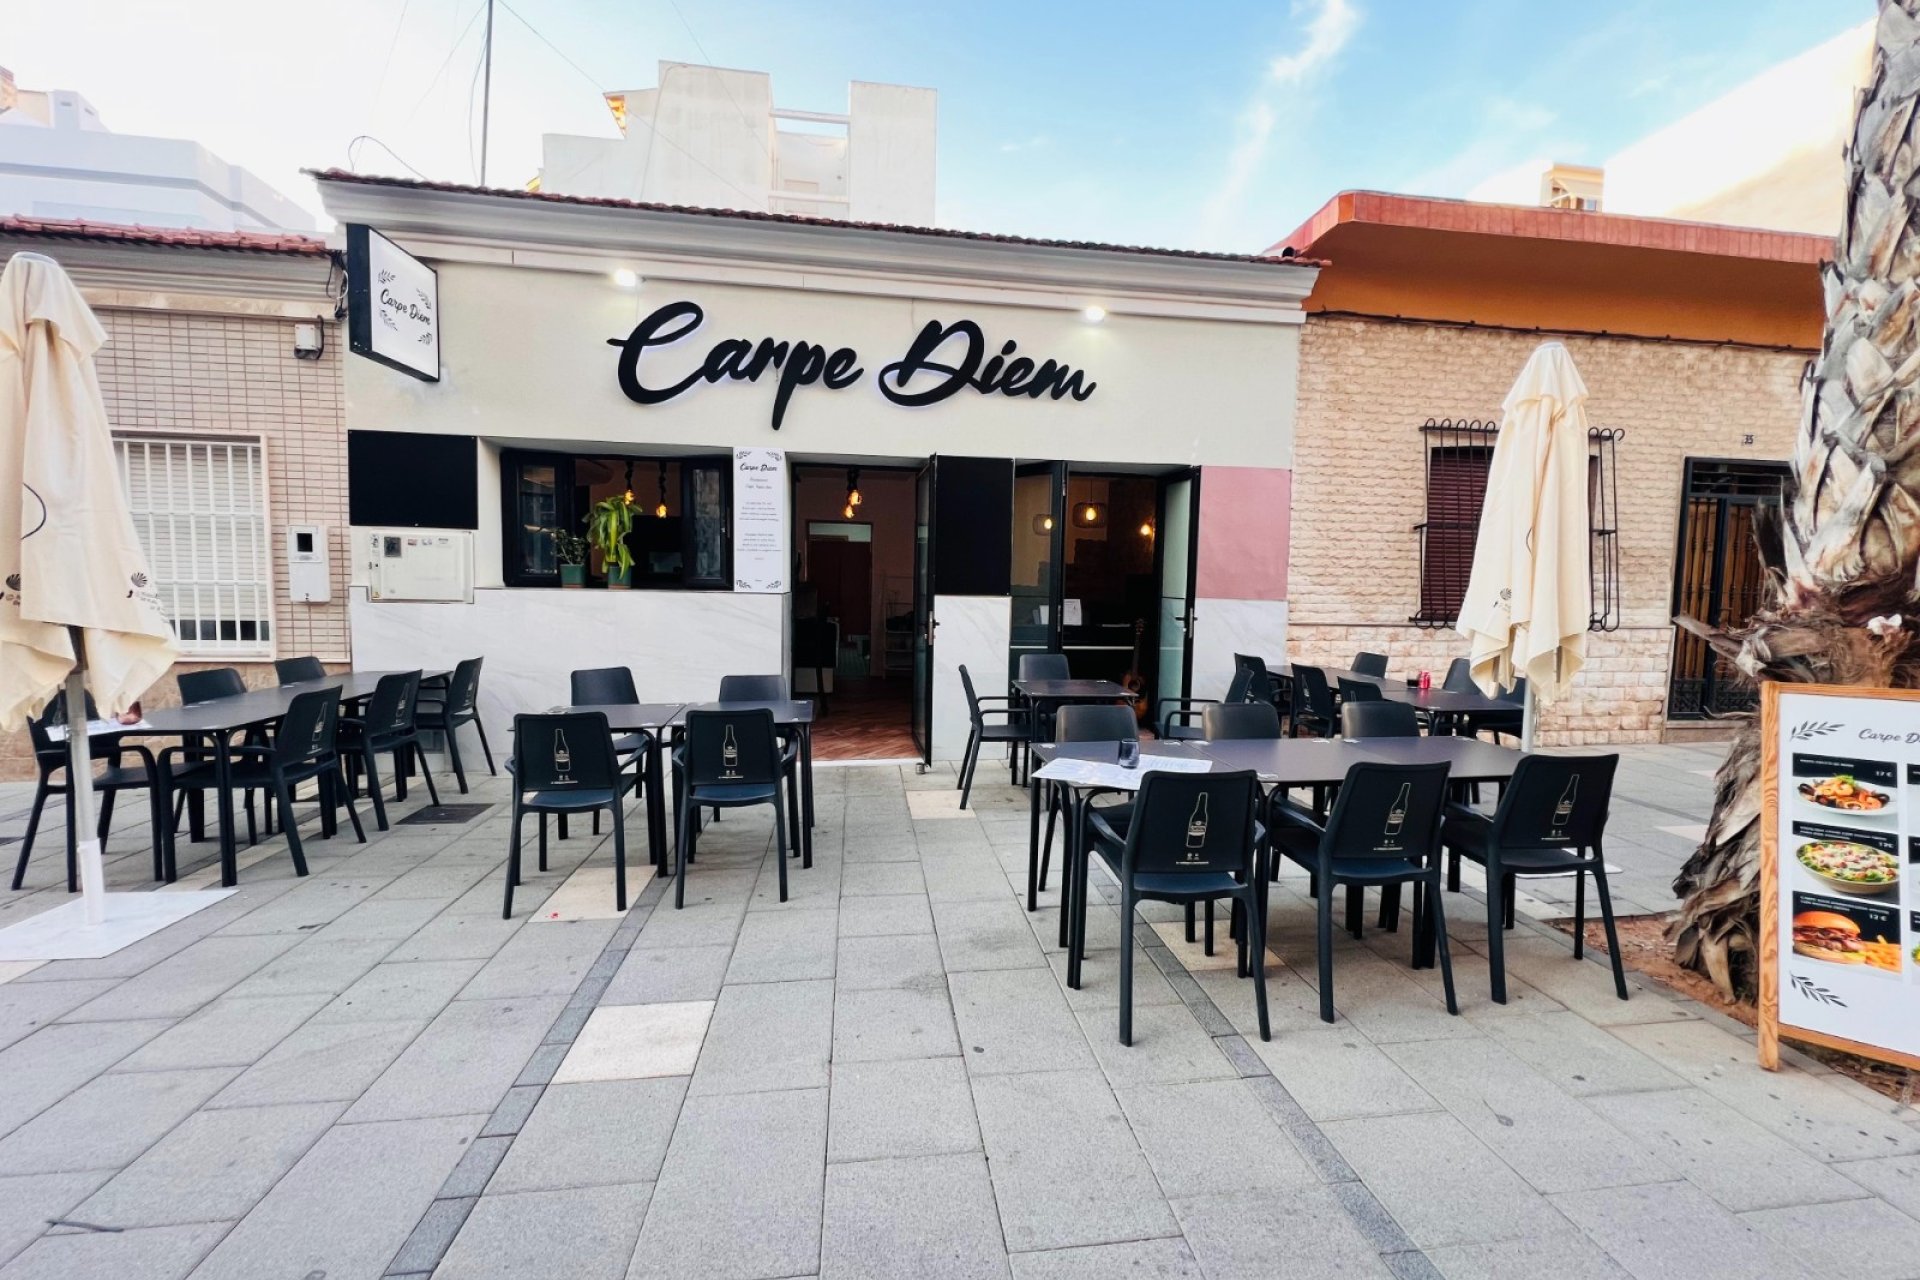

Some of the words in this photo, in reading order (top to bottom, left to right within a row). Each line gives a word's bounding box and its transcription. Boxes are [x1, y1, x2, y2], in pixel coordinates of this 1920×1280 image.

[380, 288, 408, 314] Carpe
[409, 303, 431, 326] Diem
[606, 301, 865, 431] Carpe
[878, 319, 1097, 407] Diem
[1858, 728, 1901, 743] Carpe
[1905, 732, 1920, 744] D
